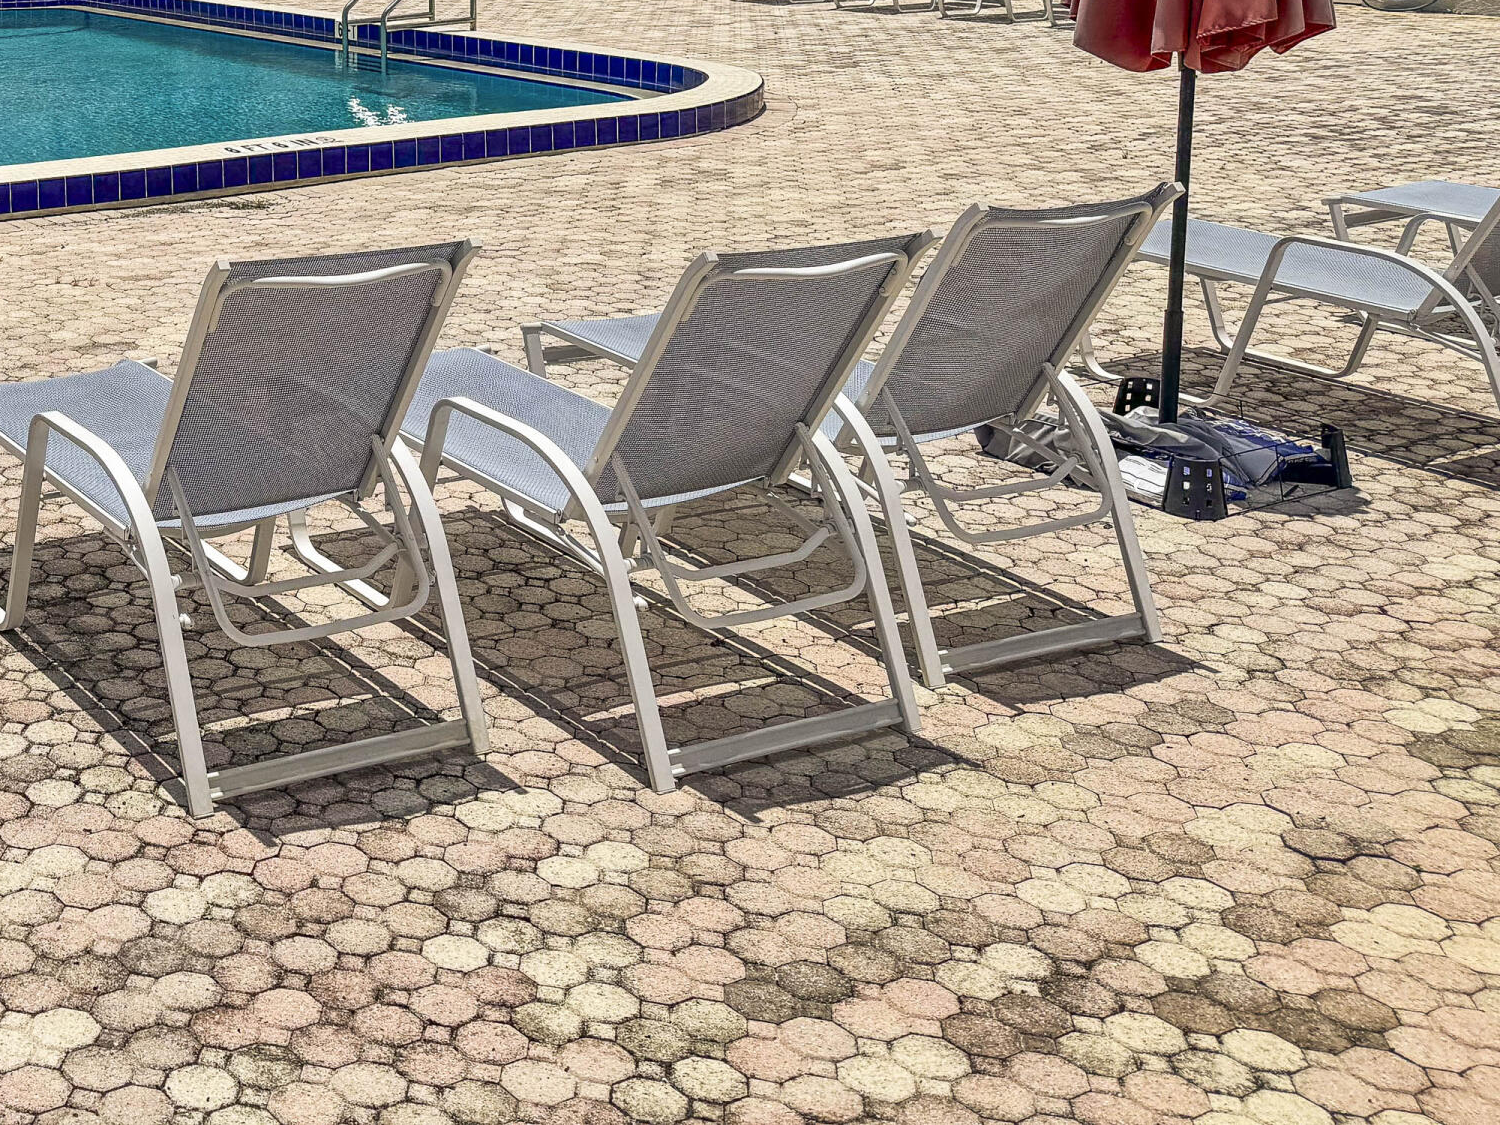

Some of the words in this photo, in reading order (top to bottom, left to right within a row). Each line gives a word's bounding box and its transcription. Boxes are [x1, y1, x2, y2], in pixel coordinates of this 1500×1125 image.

[224, 146, 241, 154] 6
[240, 143, 269, 152] FT
[290, 138, 319, 147] IN
